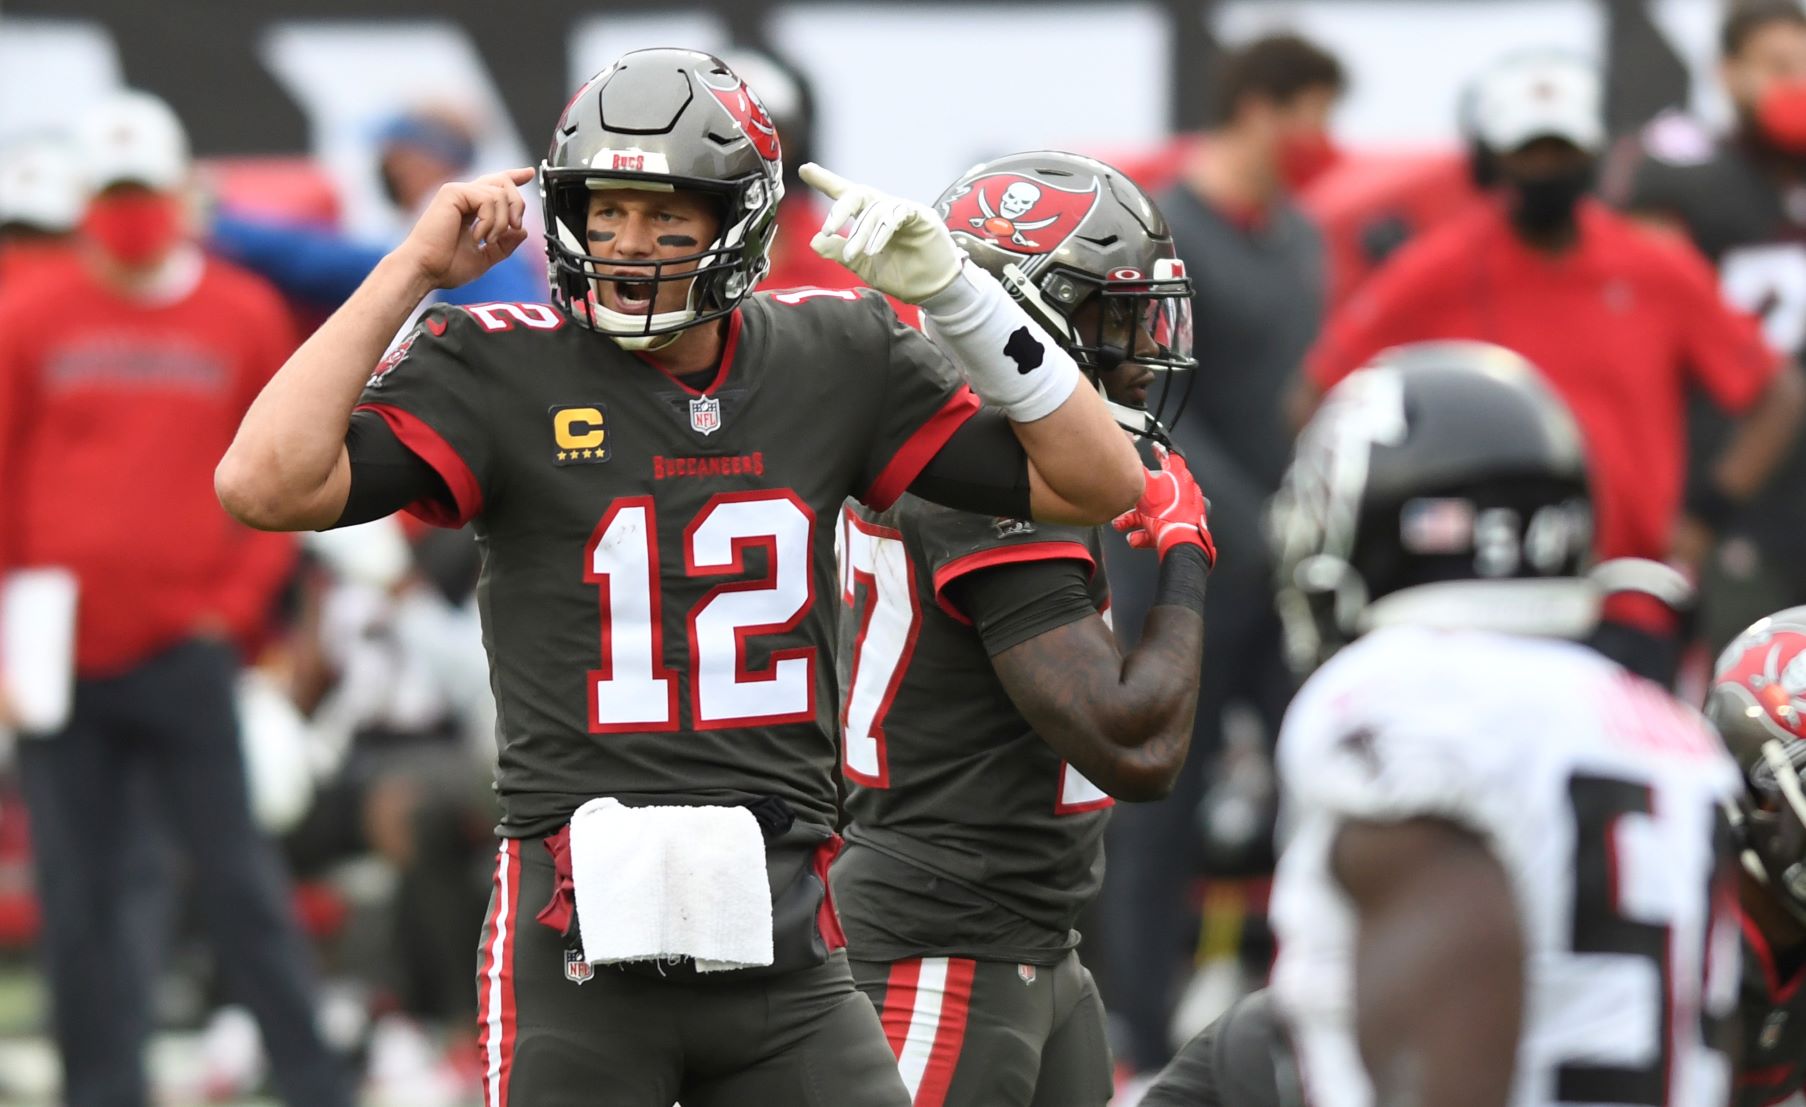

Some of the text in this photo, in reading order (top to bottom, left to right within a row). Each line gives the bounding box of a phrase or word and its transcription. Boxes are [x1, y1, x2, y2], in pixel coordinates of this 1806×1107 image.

[554, 408, 604, 449] C
[696, 413, 716, 427] NFL
[653, 451, 764, 480] BUCCANEERS
[583, 488, 817, 733] 12
